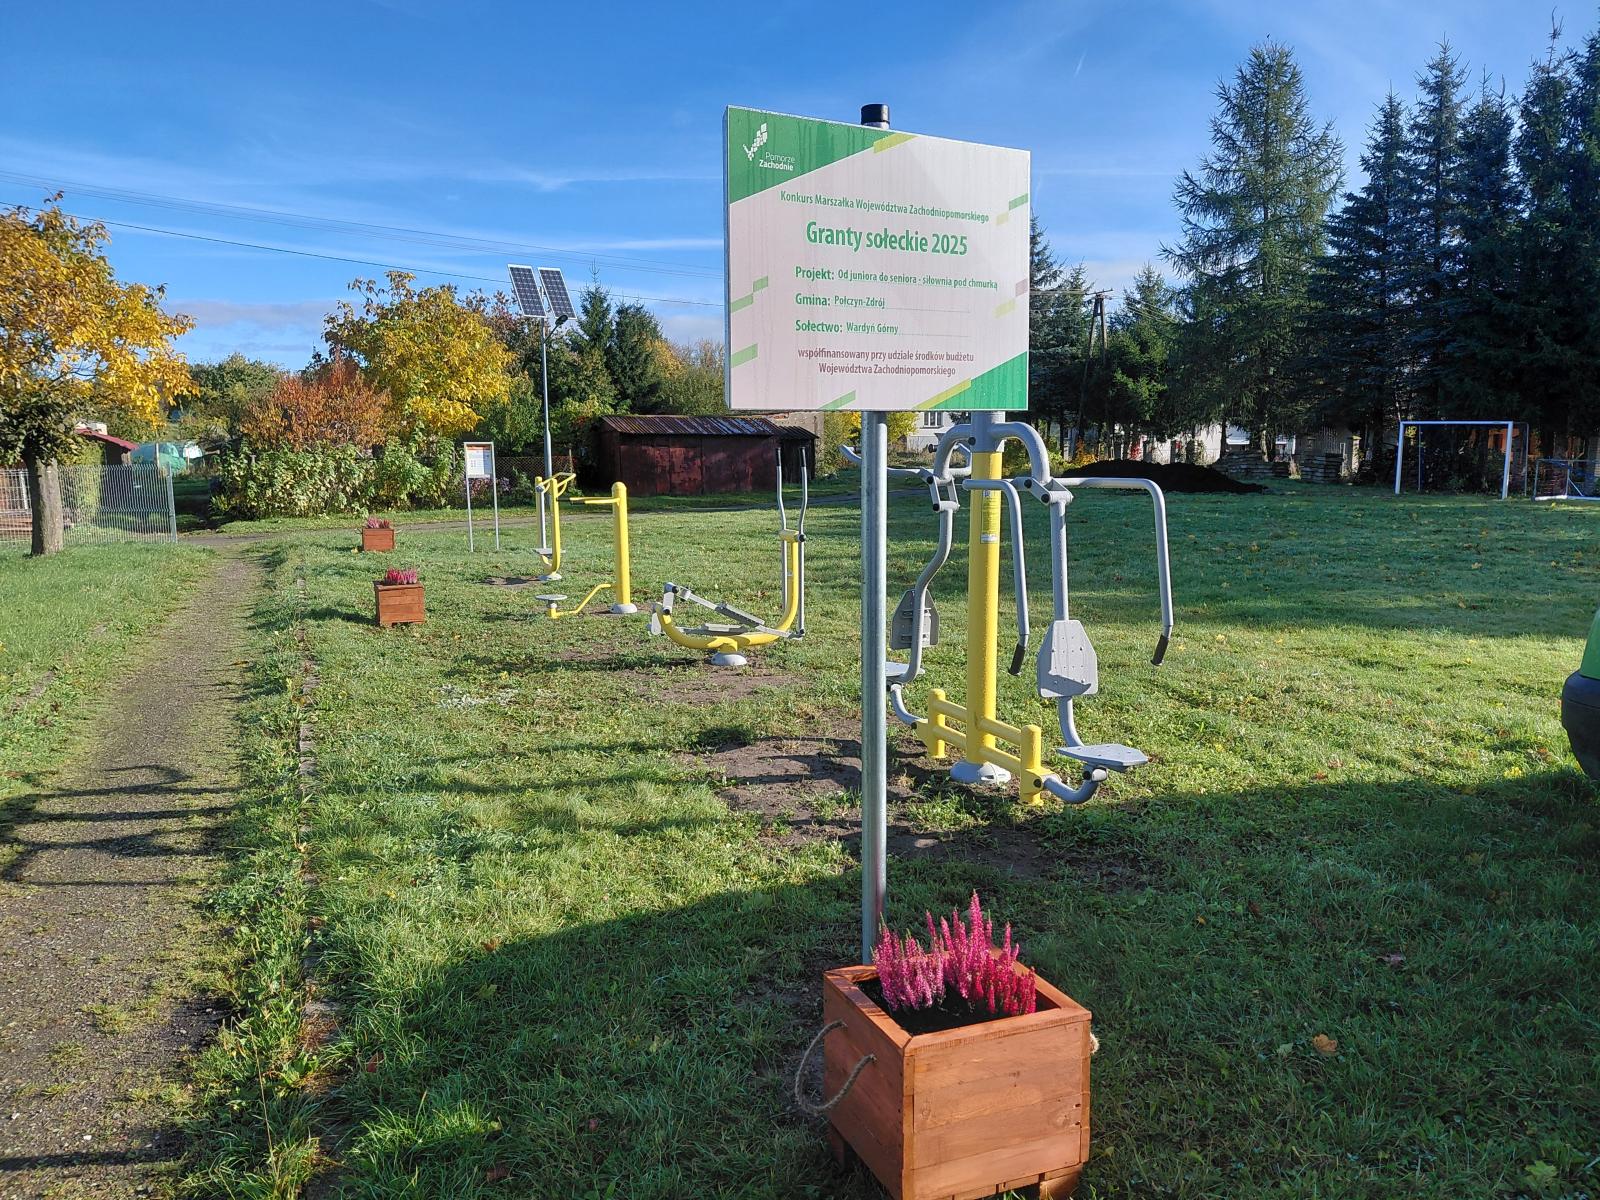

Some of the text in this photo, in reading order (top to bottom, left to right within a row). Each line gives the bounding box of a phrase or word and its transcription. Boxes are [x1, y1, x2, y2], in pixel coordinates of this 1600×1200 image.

[759, 159, 793, 172] Zachodnie
[780, 190, 989, 224] Konkurs Marszałka Województwa Zachodniopomorskiego
[806, 221, 968, 256] Granty sołeckie 2025
[795, 266, 834, 281] Projekt:
[838, 269, 848, 279] Od
[849, 271, 877, 282] juniora
[879, 272, 889, 282] do
[890, 275, 917, 284] seniora
[923, 277, 952, 286] siłownia
[953, 278, 967, 288] pod
[968, 280, 998, 292] chmurką
[795, 293, 885, 309] Gmina: Połczyn-Zdrój
[795, 319, 899, 335] Sołectwo: Wardyń Górny
[798, 348, 974, 362] współfinansowany przy udziale środków budżetu
[818, 362, 956, 377] Województwa Zachodniopomorskiego
